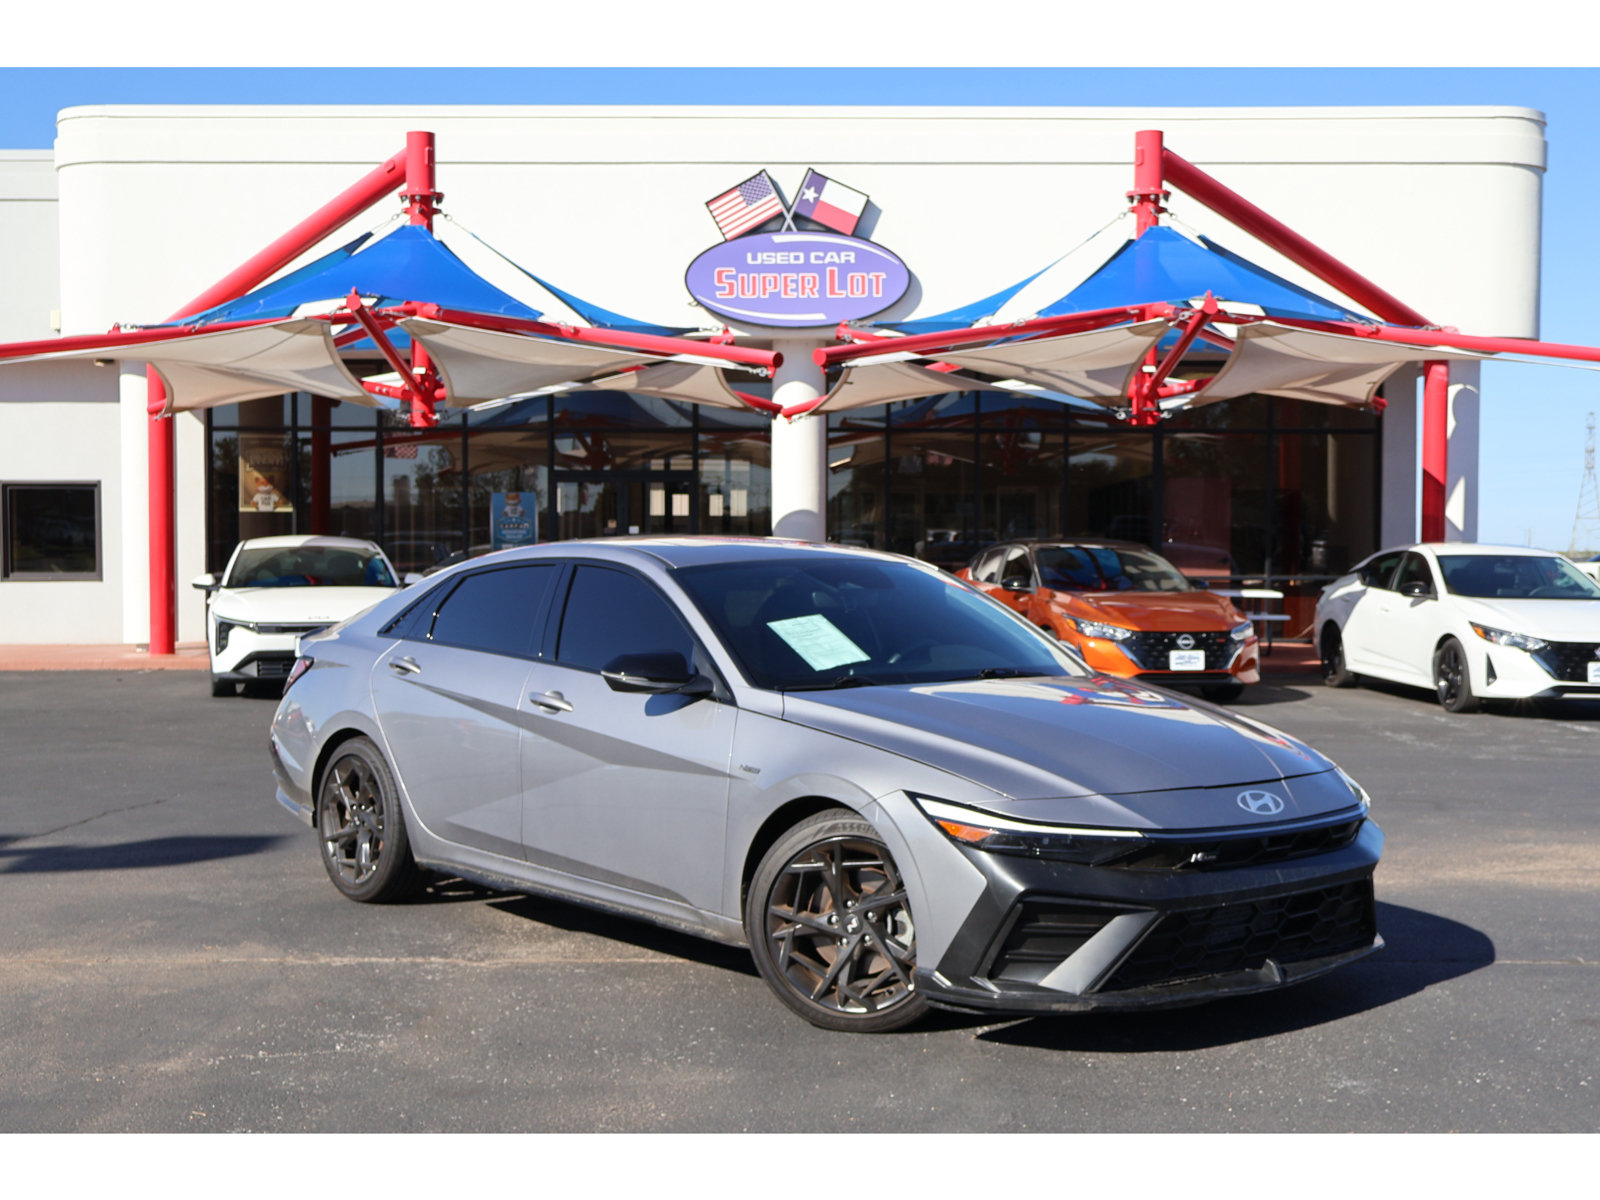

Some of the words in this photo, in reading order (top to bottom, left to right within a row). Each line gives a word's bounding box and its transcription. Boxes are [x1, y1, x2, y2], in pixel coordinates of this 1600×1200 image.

[746, 252, 804, 264] USED
[810, 251, 856, 264] CAR
[715, 267, 819, 298] SUPER
[826, 267, 887, 298] LOT
